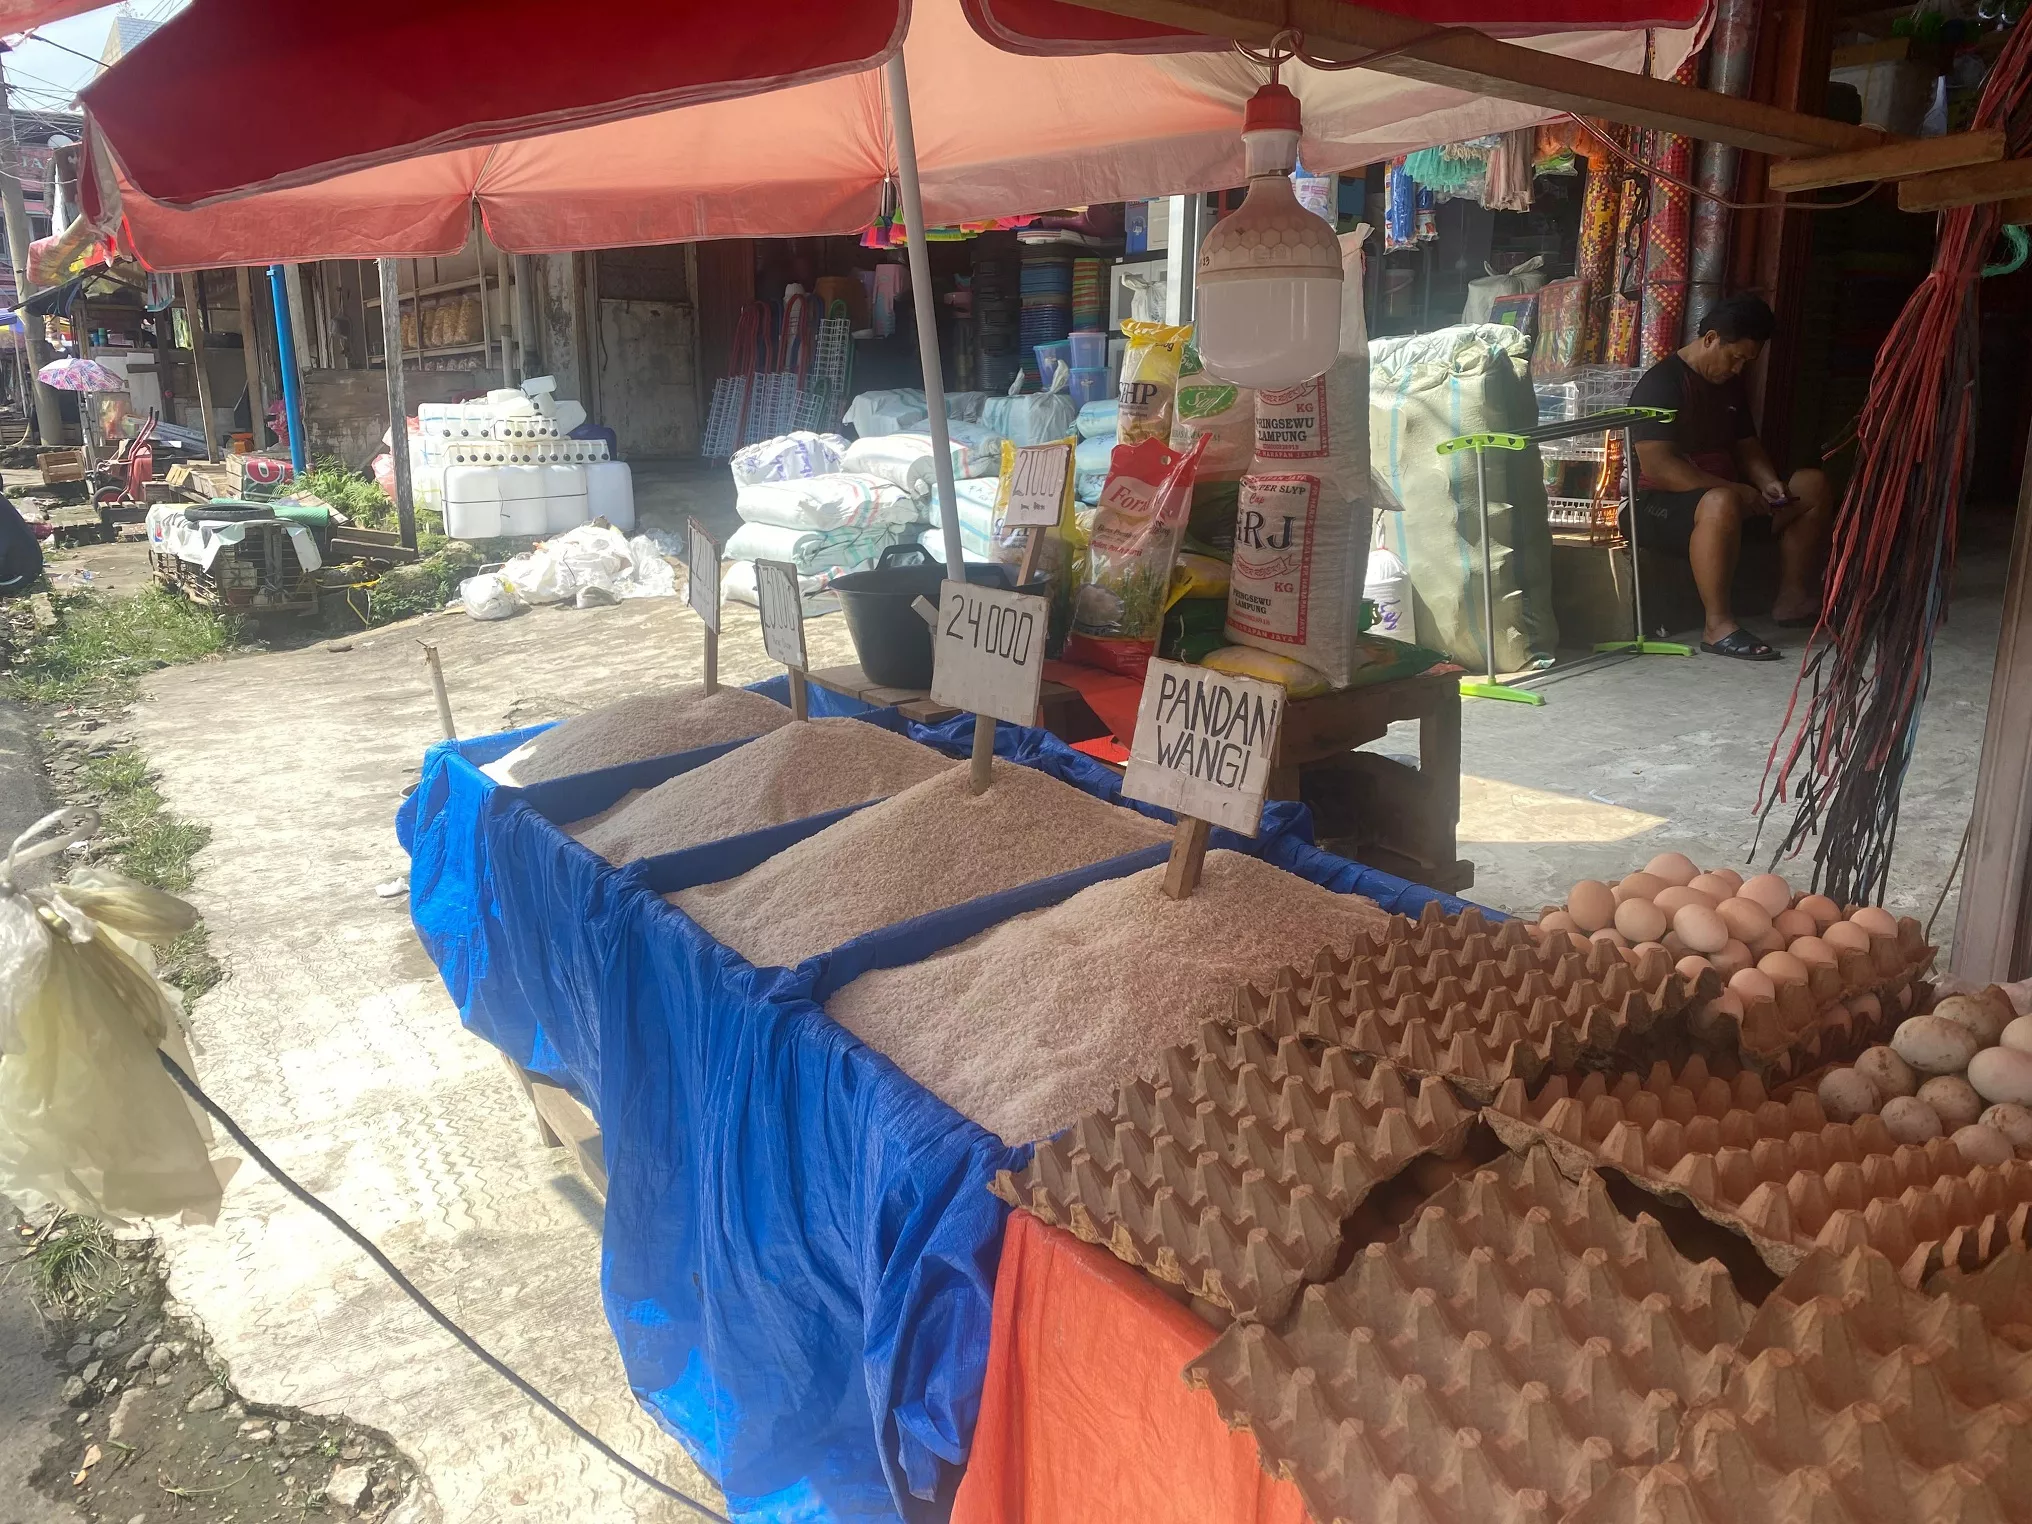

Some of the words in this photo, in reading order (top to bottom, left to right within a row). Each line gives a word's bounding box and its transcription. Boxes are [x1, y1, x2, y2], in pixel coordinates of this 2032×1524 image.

[1296, 403, 1314, 413] KG
[1259, 431, 1307, 441] LAMPUNG
[1274, 581, 1294, 593] KG
[946, 594, 1033, 666] 24000
[1156, 673, 1278, 747] PANDAN
[1157, 725, 1251, 791] WANGI
